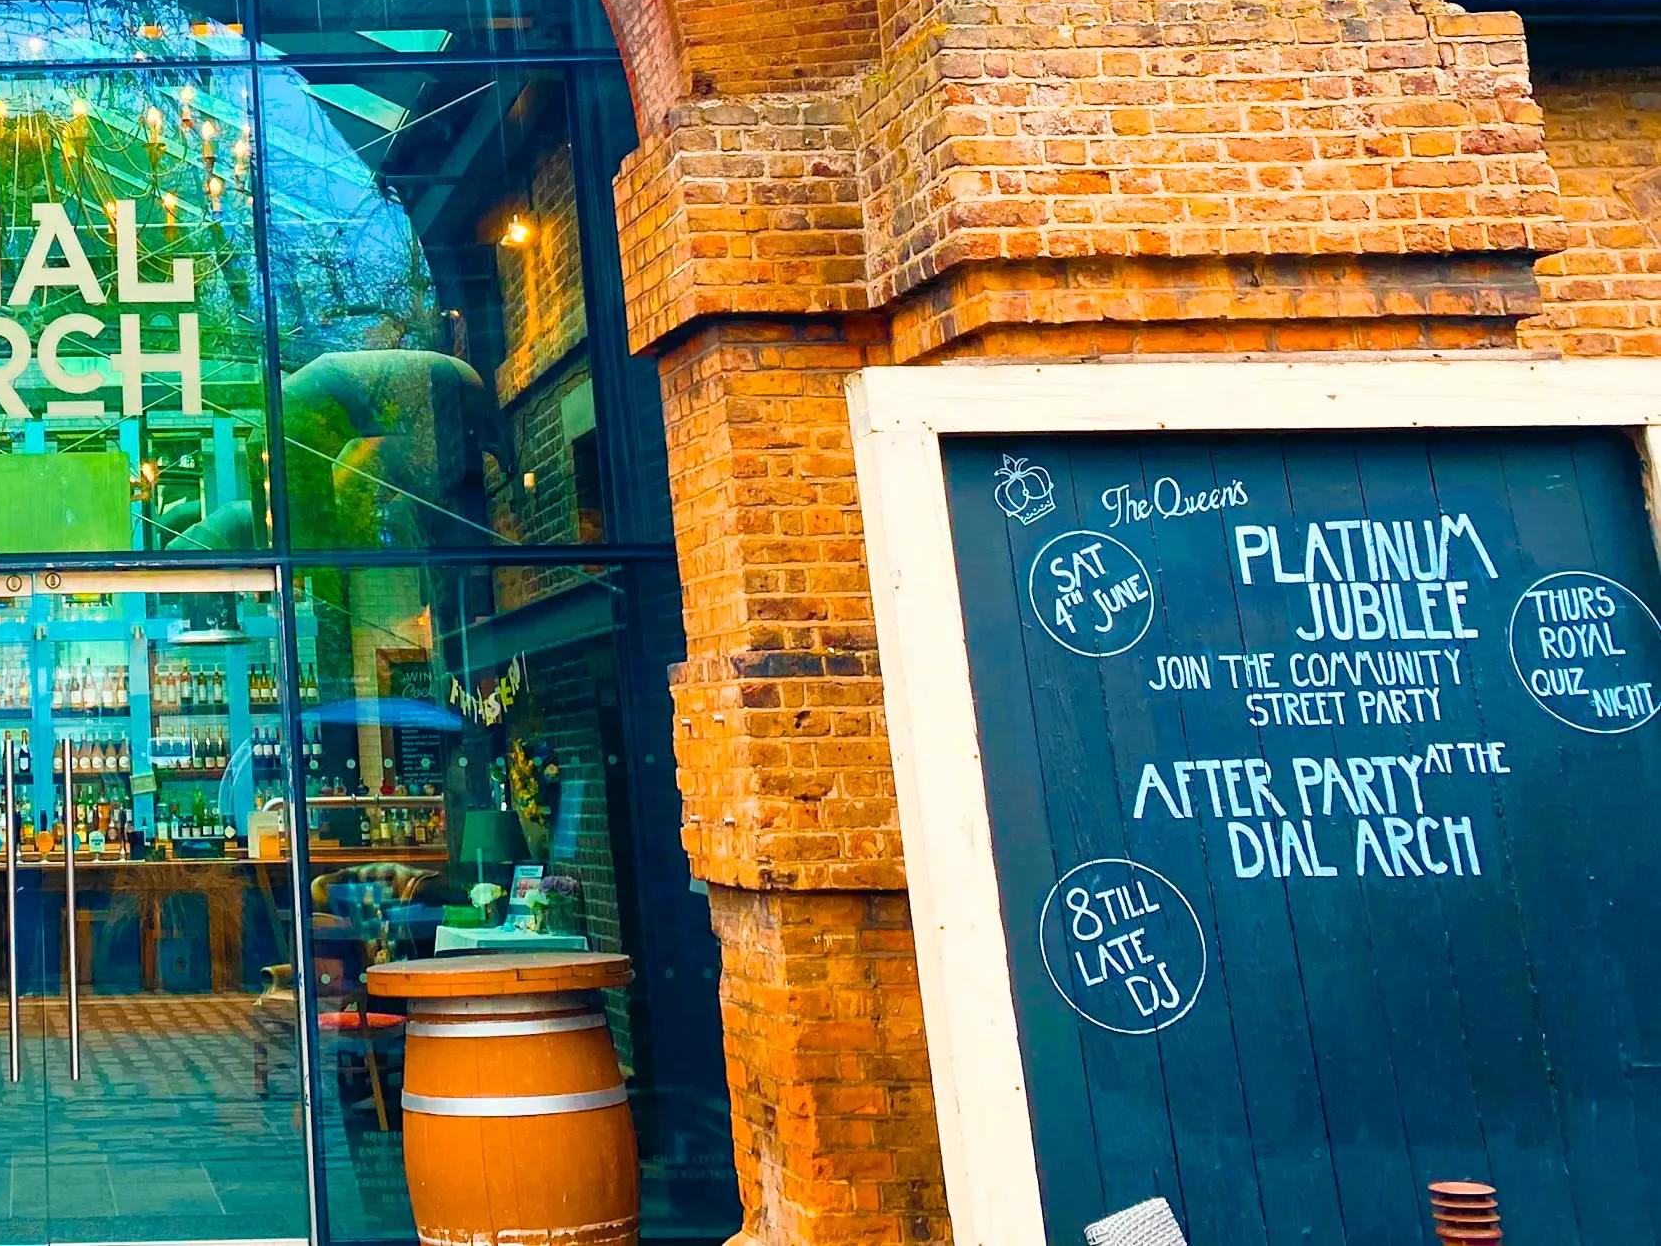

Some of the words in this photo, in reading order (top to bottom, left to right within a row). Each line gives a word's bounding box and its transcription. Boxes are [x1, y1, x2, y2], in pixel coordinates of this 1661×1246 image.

[1101, 483, 1154, 528] The
[1153, 476, 1249, 520] Queen's
[1050, 542, 1106, 593] SAT
[1234, 513, 1499, 585] PLATINUM
[1055, 589, 1084, 634] 4TH
[1092, 574, 1149, 633] JUNE
[1295, 580, 1479, 642] JUBILEE
[1527, 586, 1616, 624] THURS
[1539, 620, 1626, 660] ROYAL
[1149, 655, 1212, 691] JOIN
[1219, 653, 1280, 689] THE
[1289, 648, 1461, 688] COMMUNITY
[1530, 667, 1589, 697] QUIZ
[1246, 691, 1346, 727] STREET
[1359, 687, 1441, 725] PARTY
[1592, 682, 1654, 719] NIGHT
[1133, 758, 1286, 819] AFTER
[1292, 754, 1424, 818] PARTY
[1424, 742, 1454, 774] AT
[1457, 741, 1511, 773] THE
[1227, 819, 1338, 878] DIAL
[1356, 816, 1481, 877] ARCH
[1066, 887, 1103, 941] 8
[1095, 880, 1160, 925] TILL
[1074, 927, 1155, 987] LATE
[1124, 962, 1181, 1017] DJ
